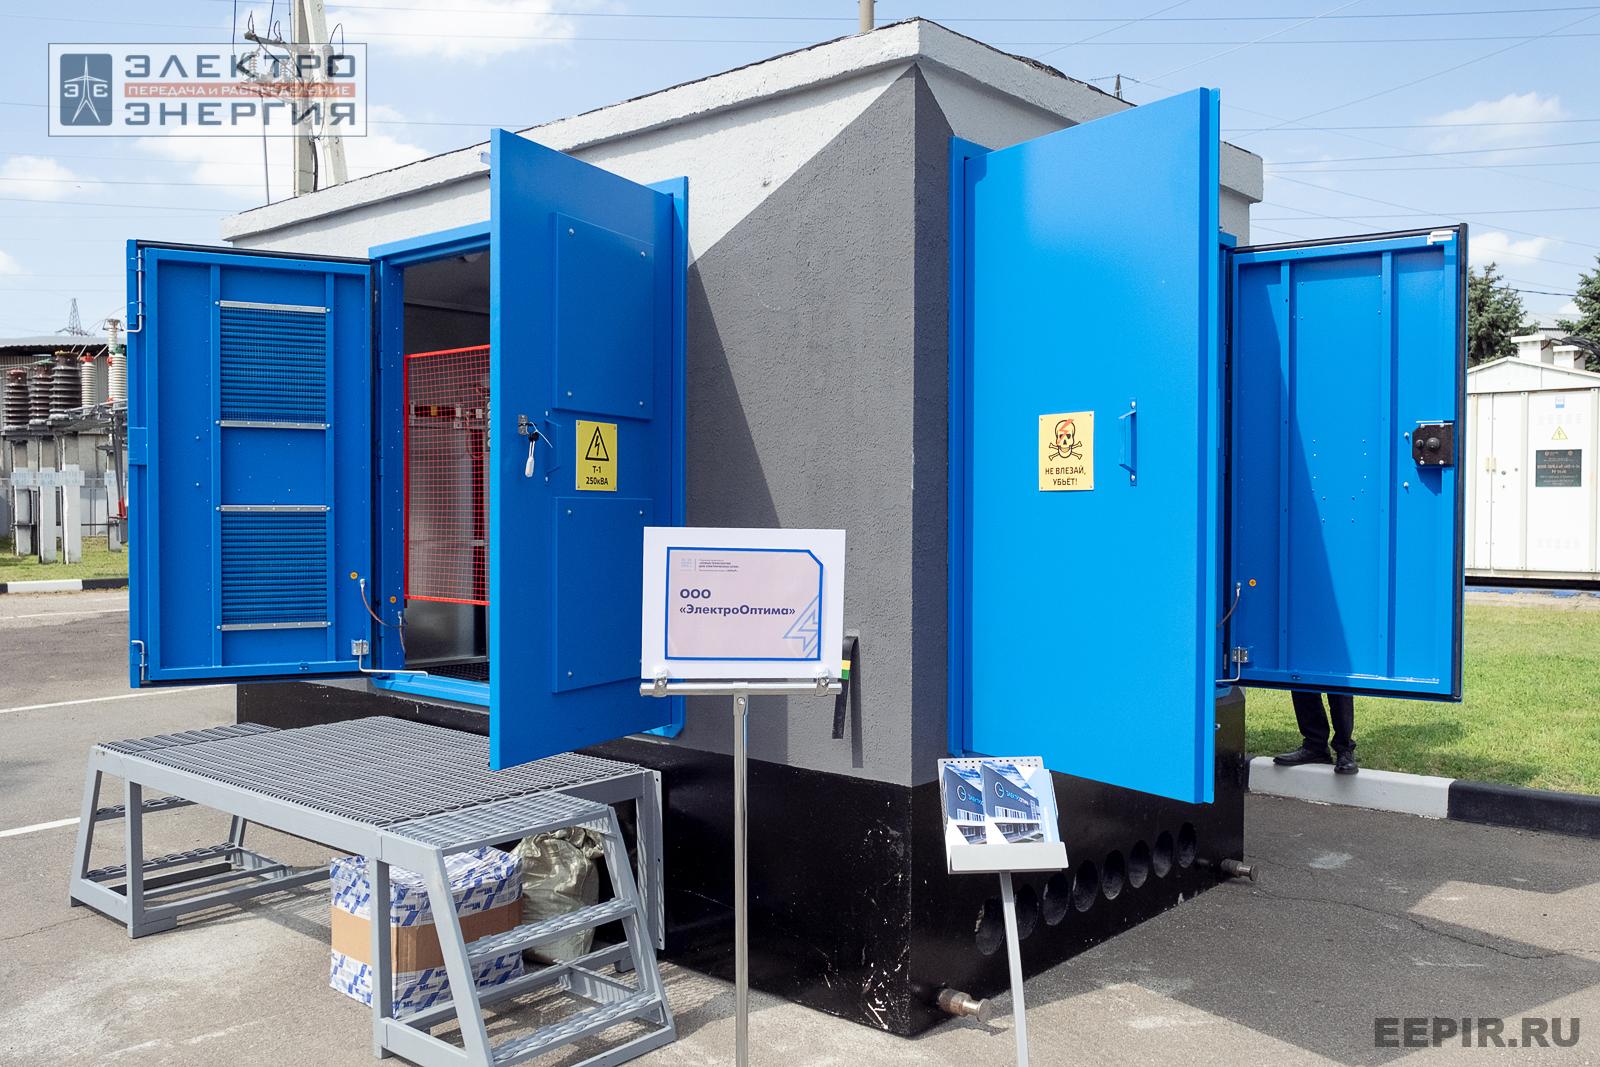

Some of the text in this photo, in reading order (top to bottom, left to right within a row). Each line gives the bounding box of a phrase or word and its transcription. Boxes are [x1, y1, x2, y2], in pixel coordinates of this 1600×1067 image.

[1045, 465, 1087, 475] НЕ ВЛЕЗАЙ,
[679, 588, 712, 599] ООО
[679, 603, 796, 617] «ЭлектроОптима»
